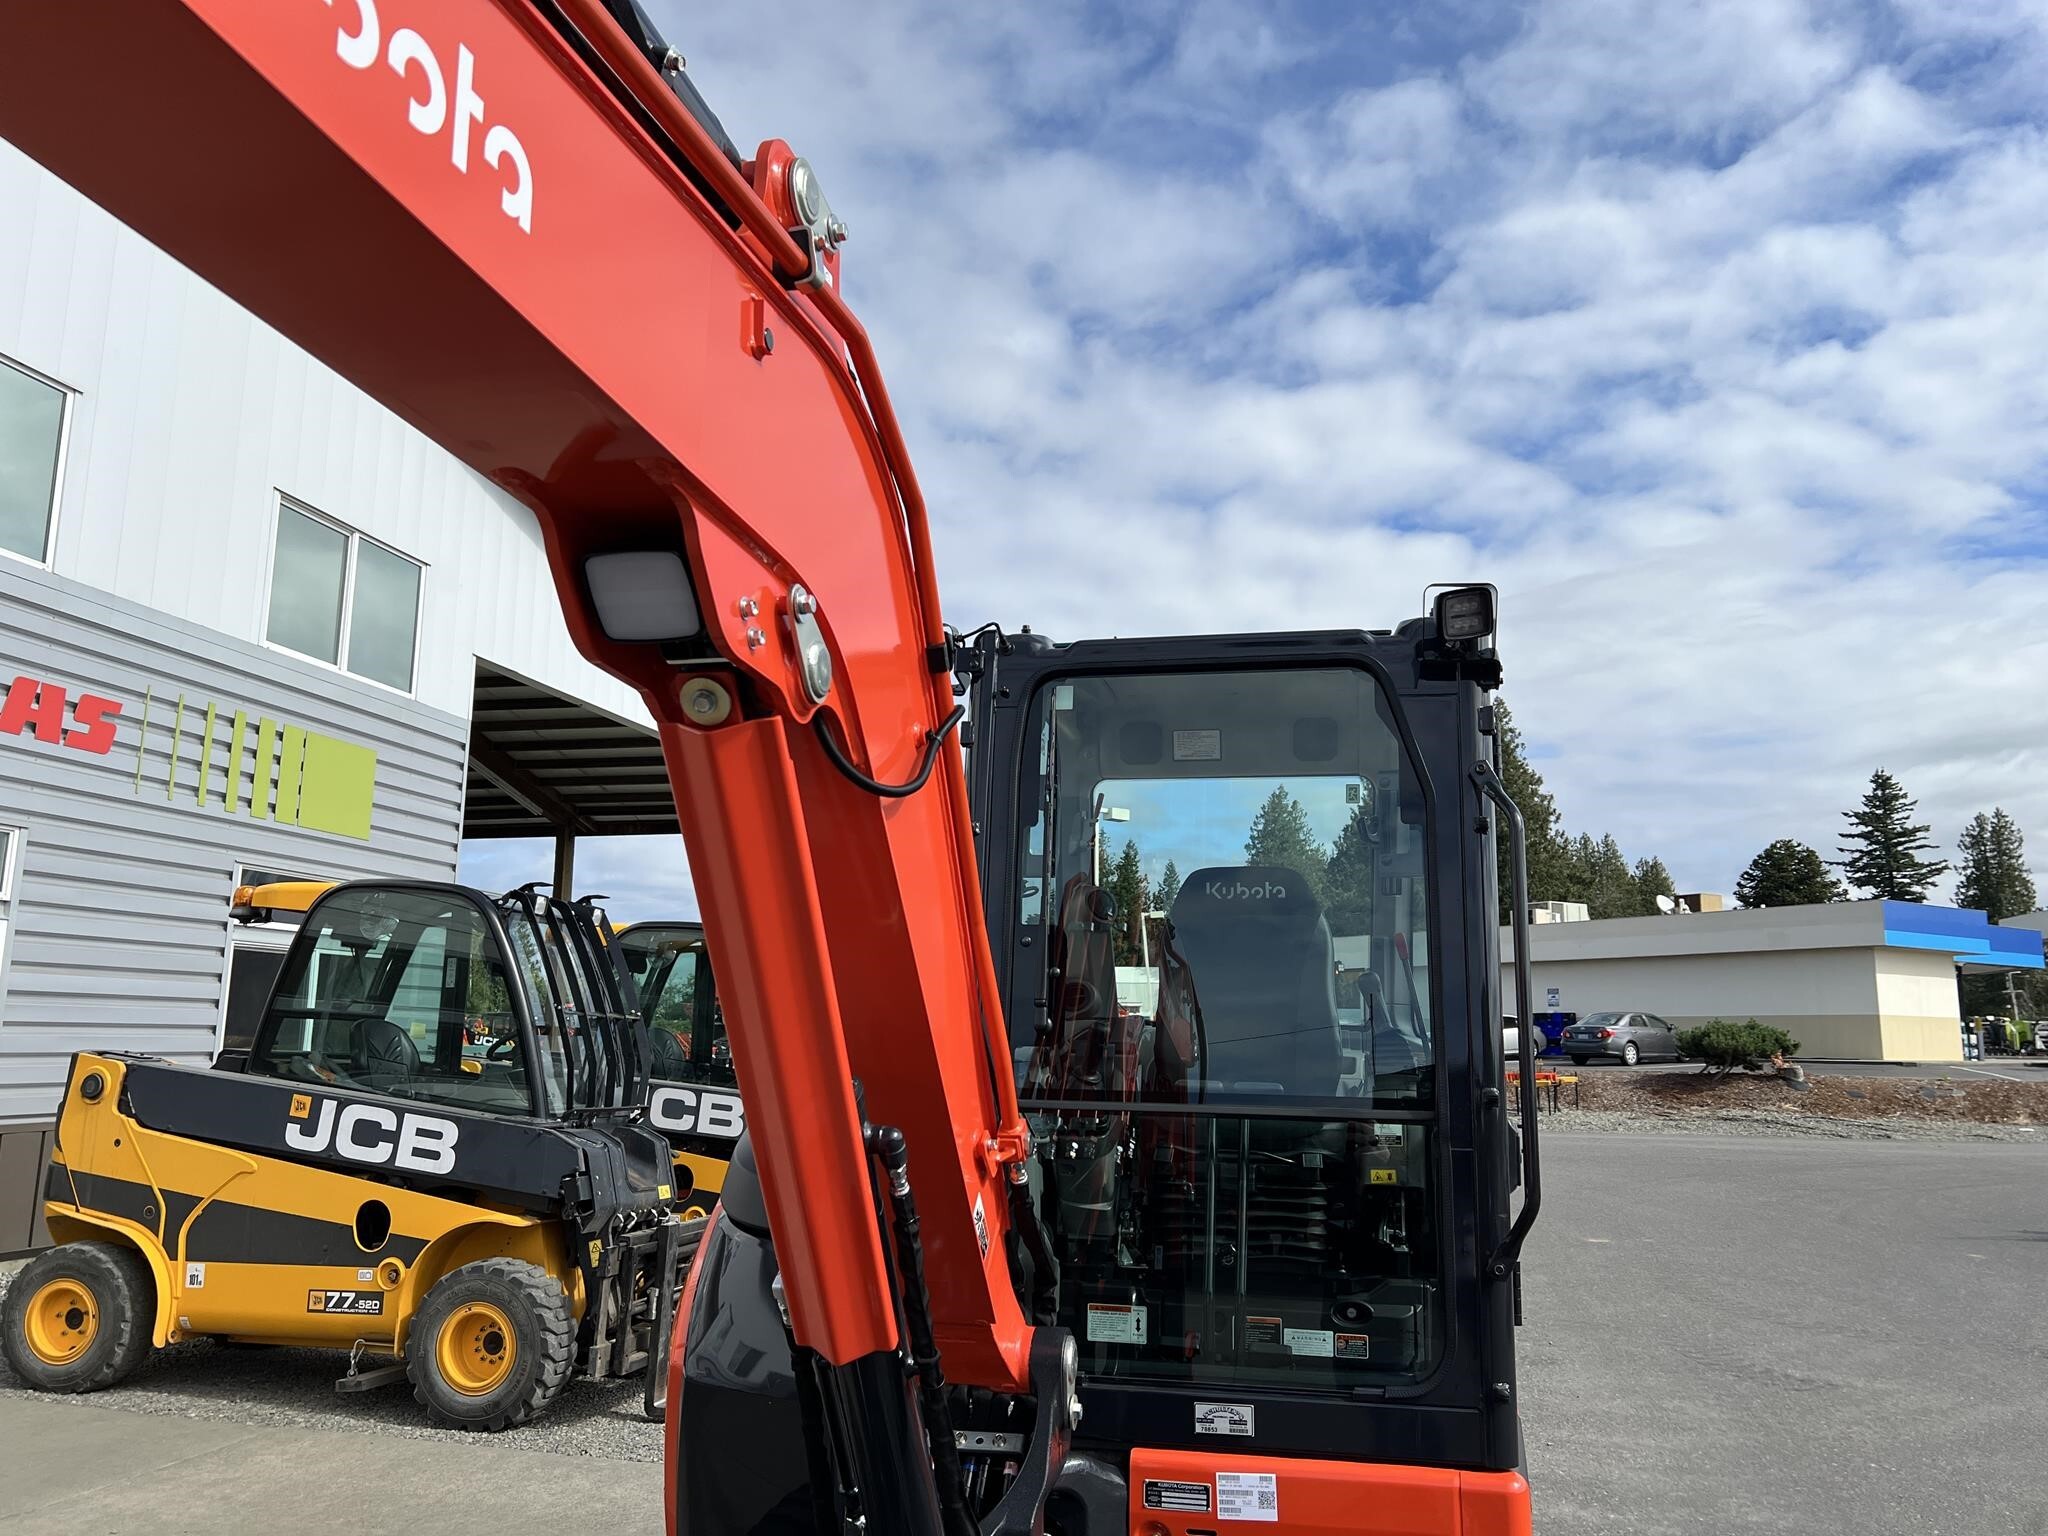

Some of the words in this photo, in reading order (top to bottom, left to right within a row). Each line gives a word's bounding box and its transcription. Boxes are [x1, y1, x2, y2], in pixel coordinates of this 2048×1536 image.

[1206, 881, 1286, 899] Kubota
[285, 1098, 459, 1175] JCB
[645, 1086, 744, 1138] CB
